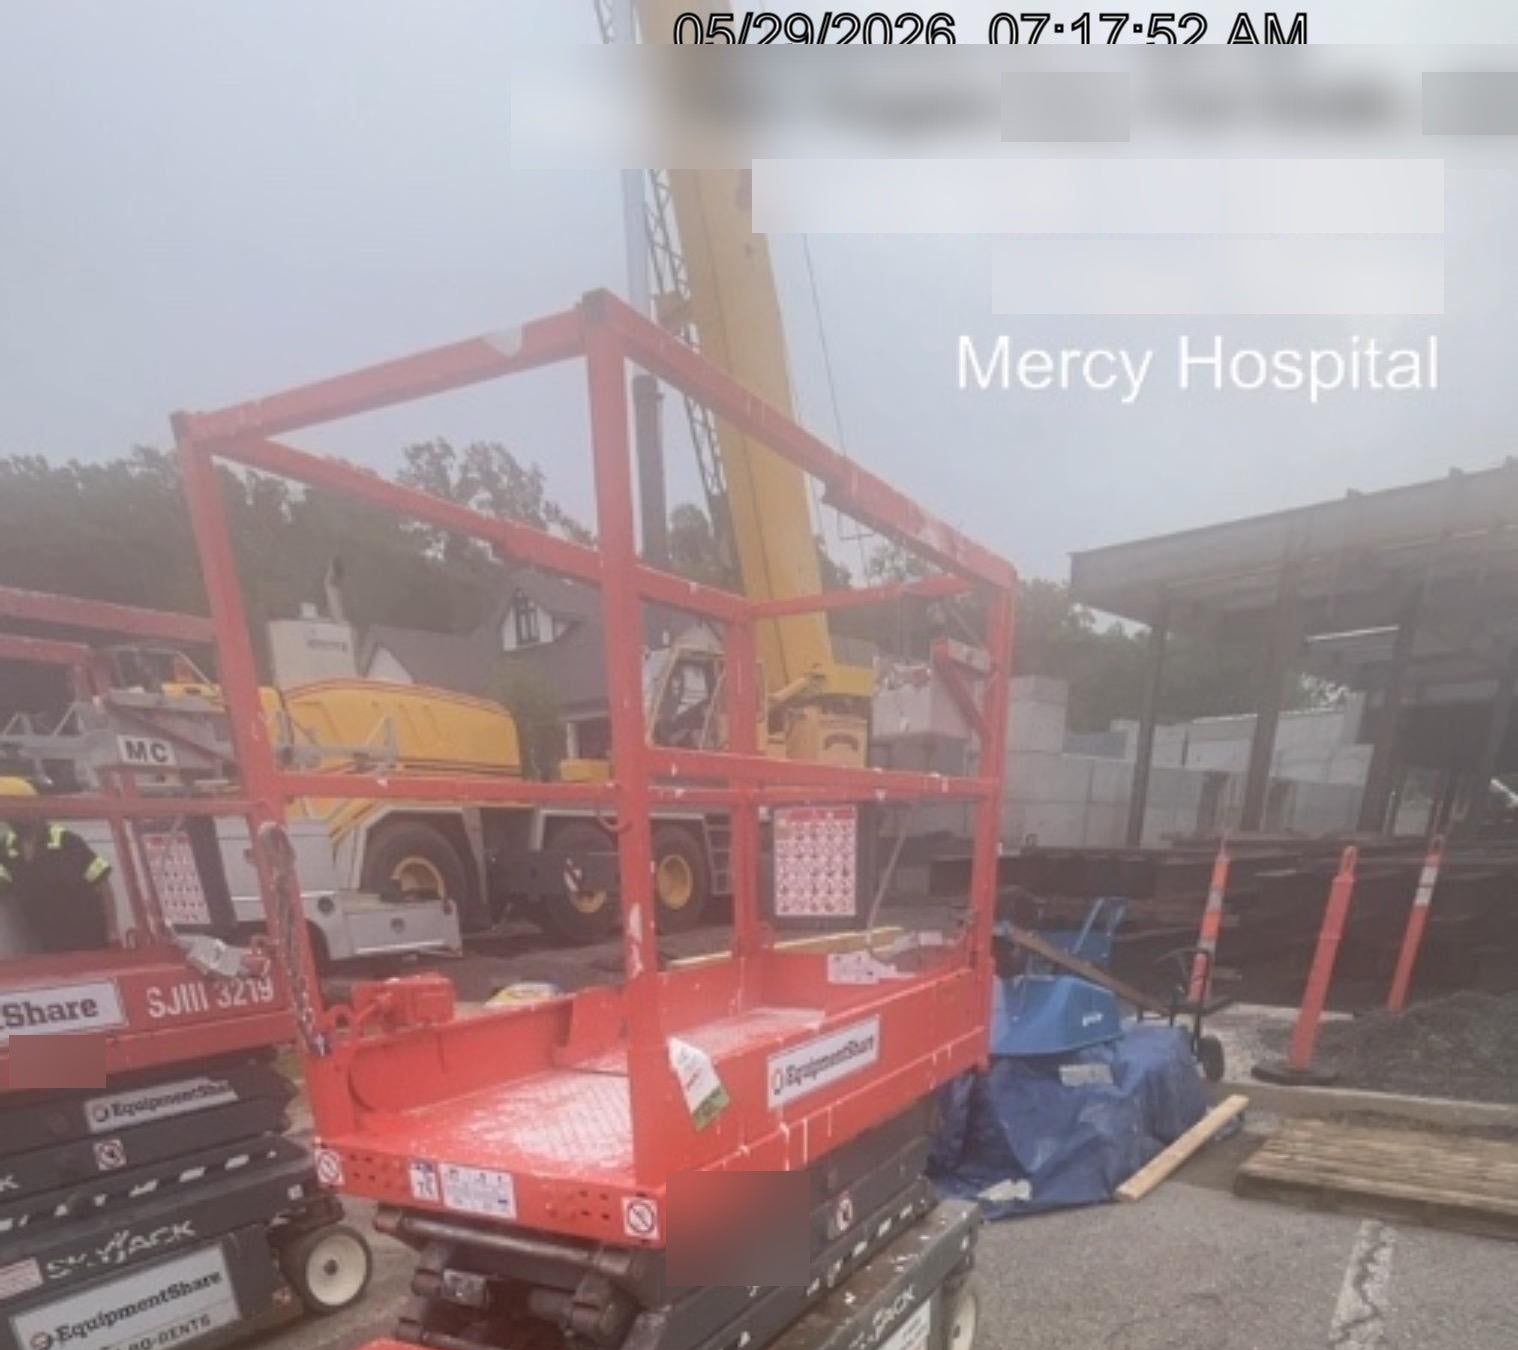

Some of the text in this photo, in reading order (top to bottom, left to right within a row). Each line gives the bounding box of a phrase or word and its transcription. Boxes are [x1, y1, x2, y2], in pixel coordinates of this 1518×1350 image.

[214, 975, 274, 1008] 3219
[0, 997, 100, 1029] Share
[54, 1271, 222, 1343] EquipmentShare
